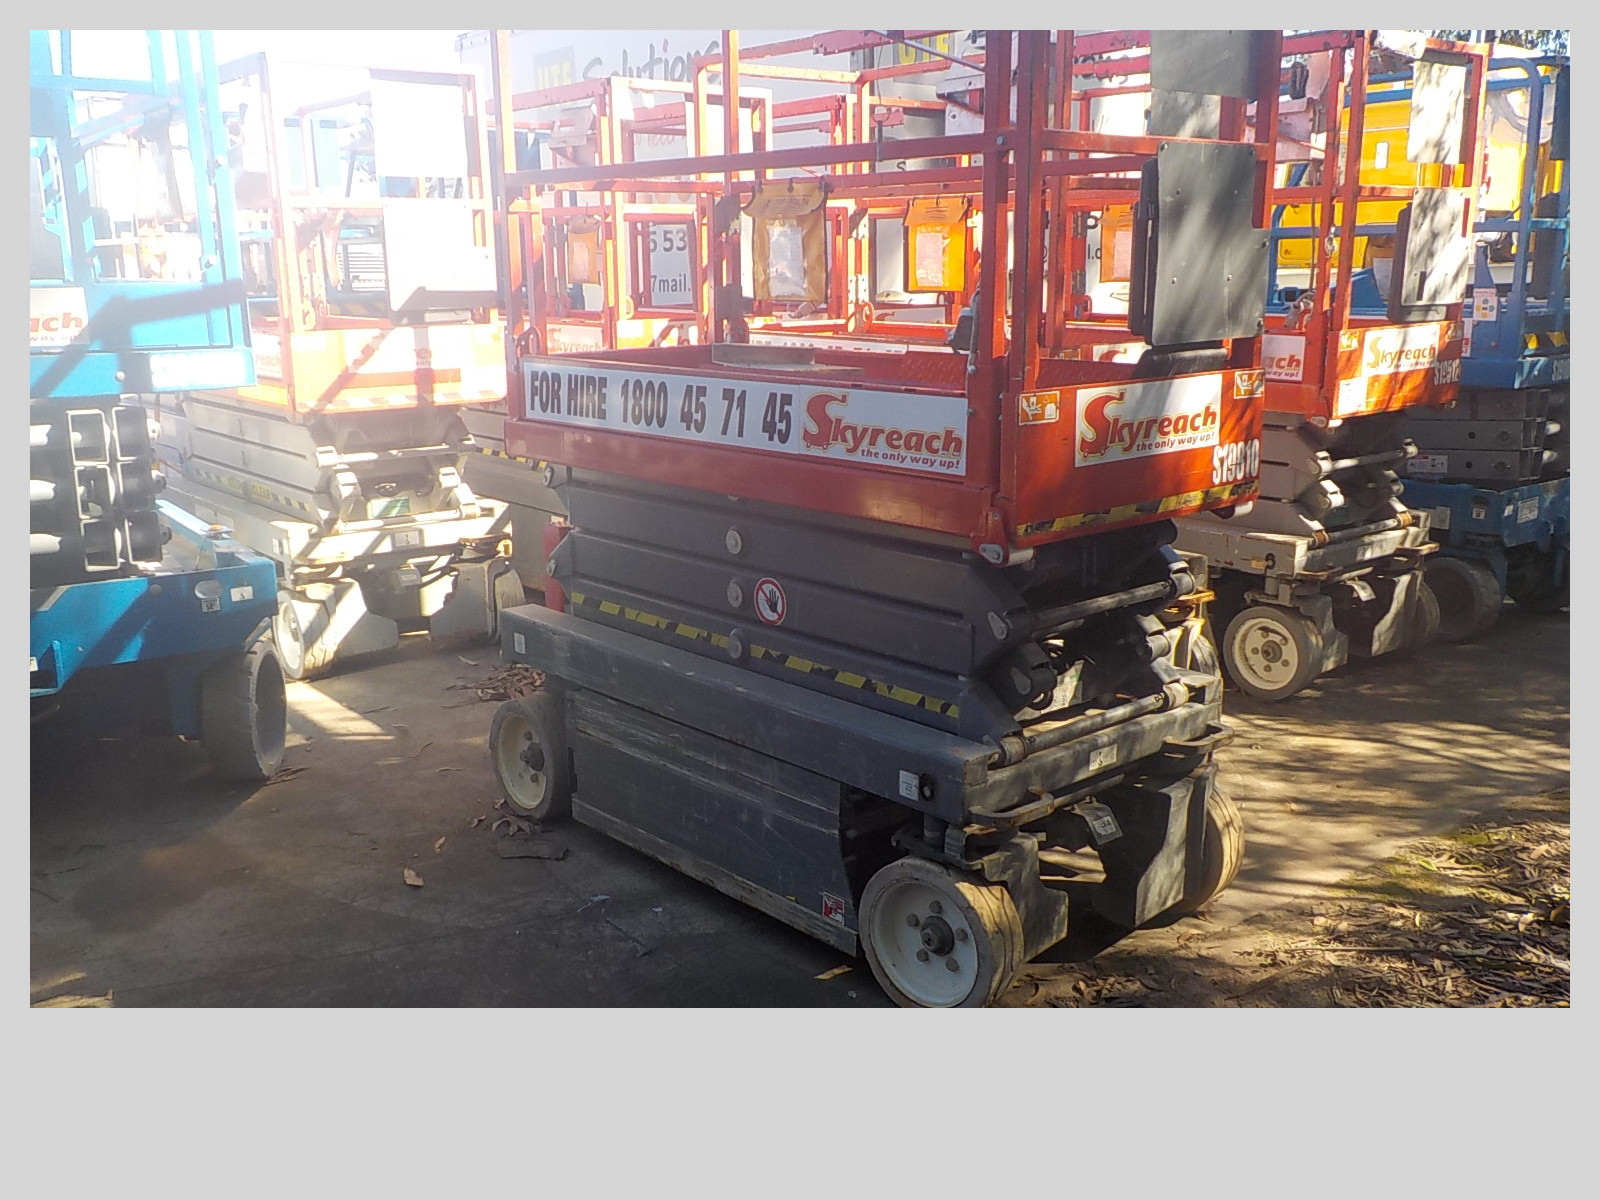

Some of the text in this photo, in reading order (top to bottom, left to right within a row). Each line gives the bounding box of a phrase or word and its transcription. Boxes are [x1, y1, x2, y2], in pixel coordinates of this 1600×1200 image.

[1367, 336, 1436, 369] Skyreach
[530, 370, 793, 444] FOR HIRE 1800 45 71 45
[803, 393, 963, 454] Skyreach
[1080, 391, 1218, 458] Skyreach
[861, 448, 961, 471] the only way up!
[1136, 432, 1215, 452] the only way up!
